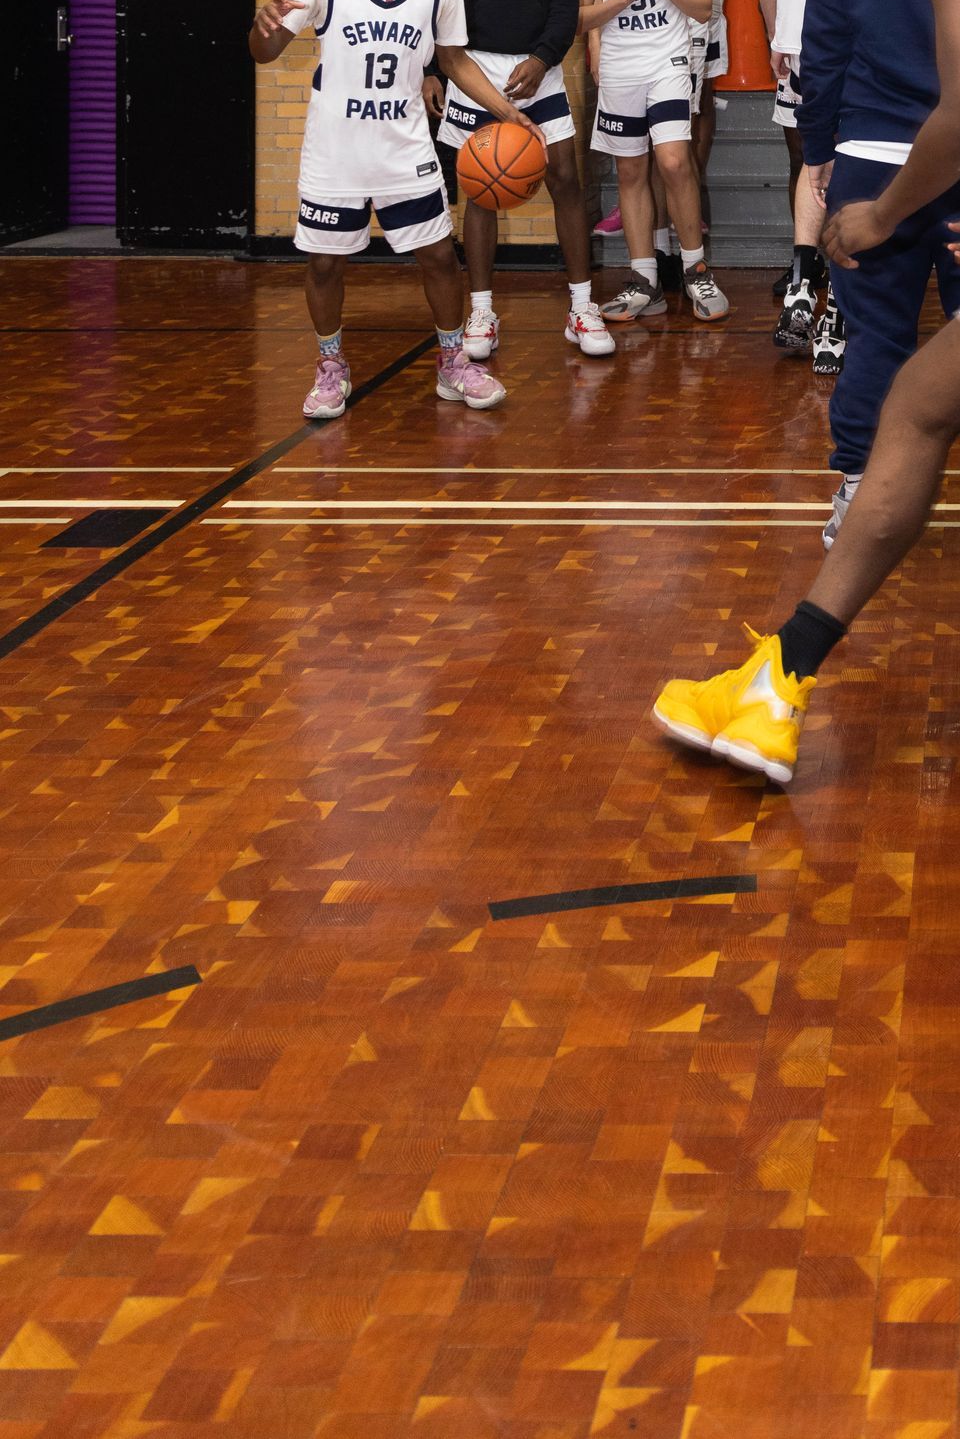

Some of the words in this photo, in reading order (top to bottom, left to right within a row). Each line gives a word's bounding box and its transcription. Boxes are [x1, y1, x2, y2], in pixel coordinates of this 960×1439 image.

[618, 9, 669, 31] PARK
[342, 21, 423, 50] SEWARD
[364, 53, 399, 90] 13
[345, 98, 408, 121] PARK
[448, 106, 477, 125] BEARS
[300, 203, 340, 225] BEARS
